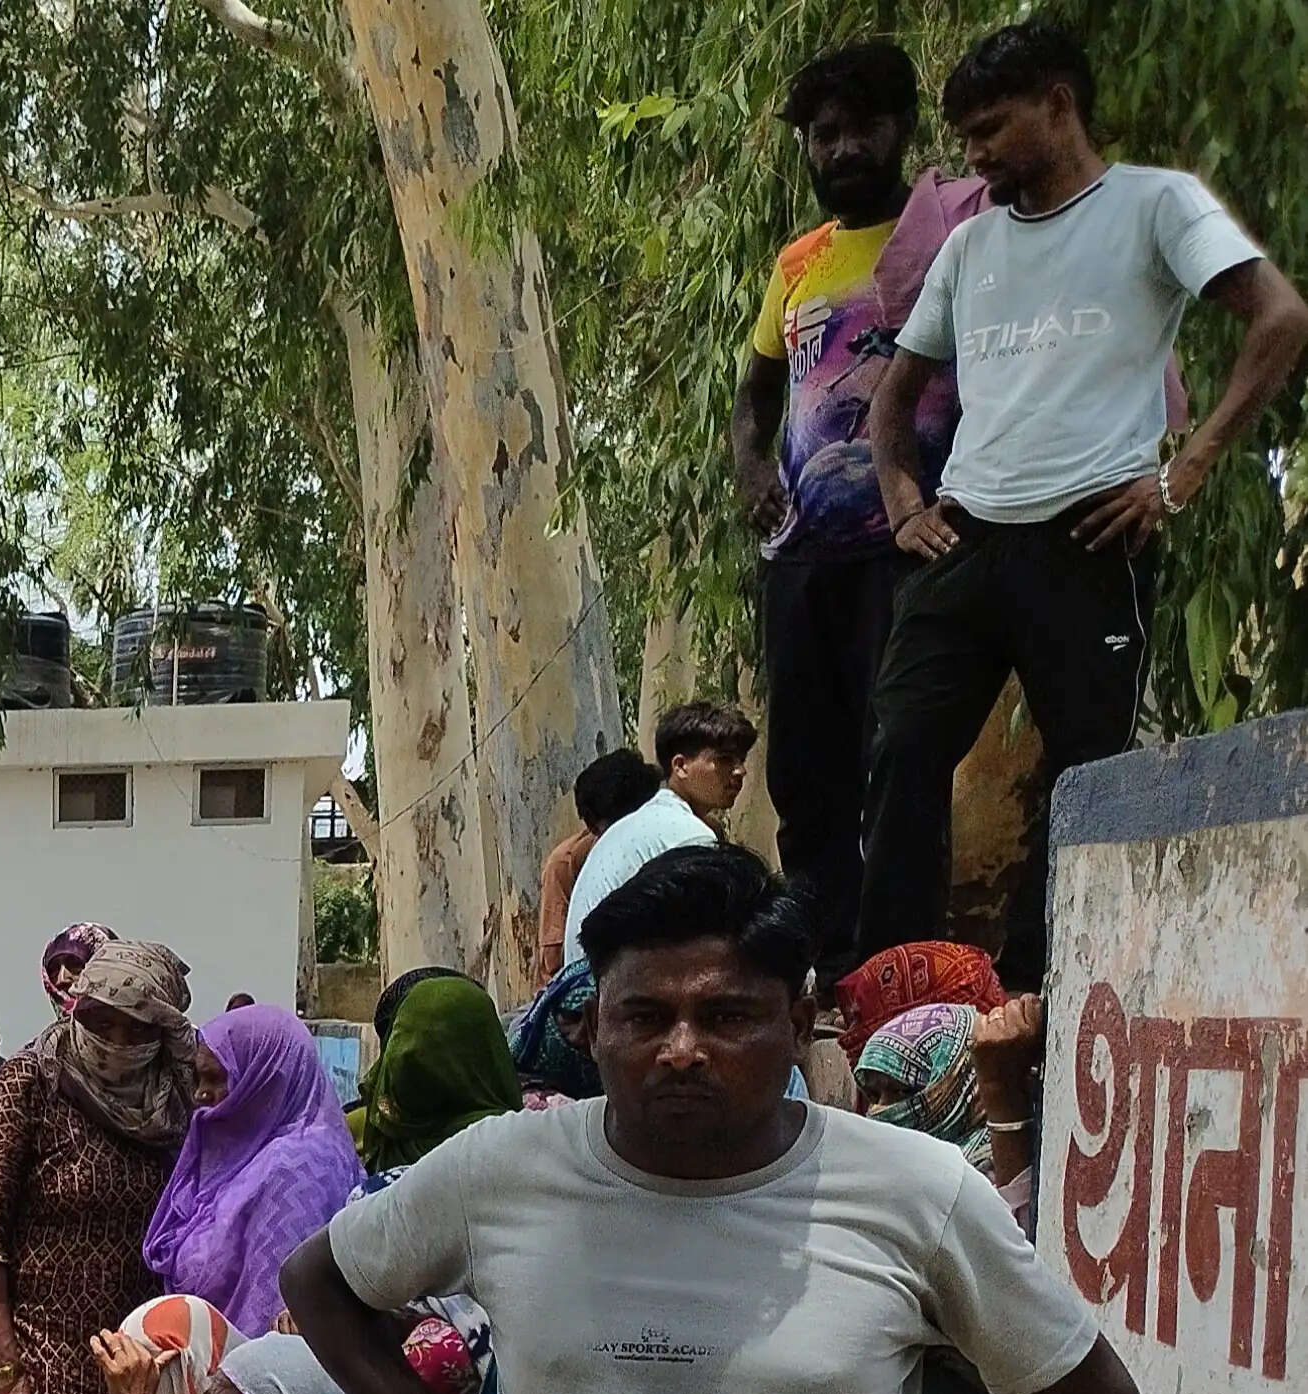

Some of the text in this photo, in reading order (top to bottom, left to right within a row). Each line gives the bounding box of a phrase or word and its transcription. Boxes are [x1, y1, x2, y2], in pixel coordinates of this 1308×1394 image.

[961, 307, 1115, 357] ETIHAD
[1063, 982, 1308, 1381] थाना
[620, 1342, 670, 1354] SPORTS
